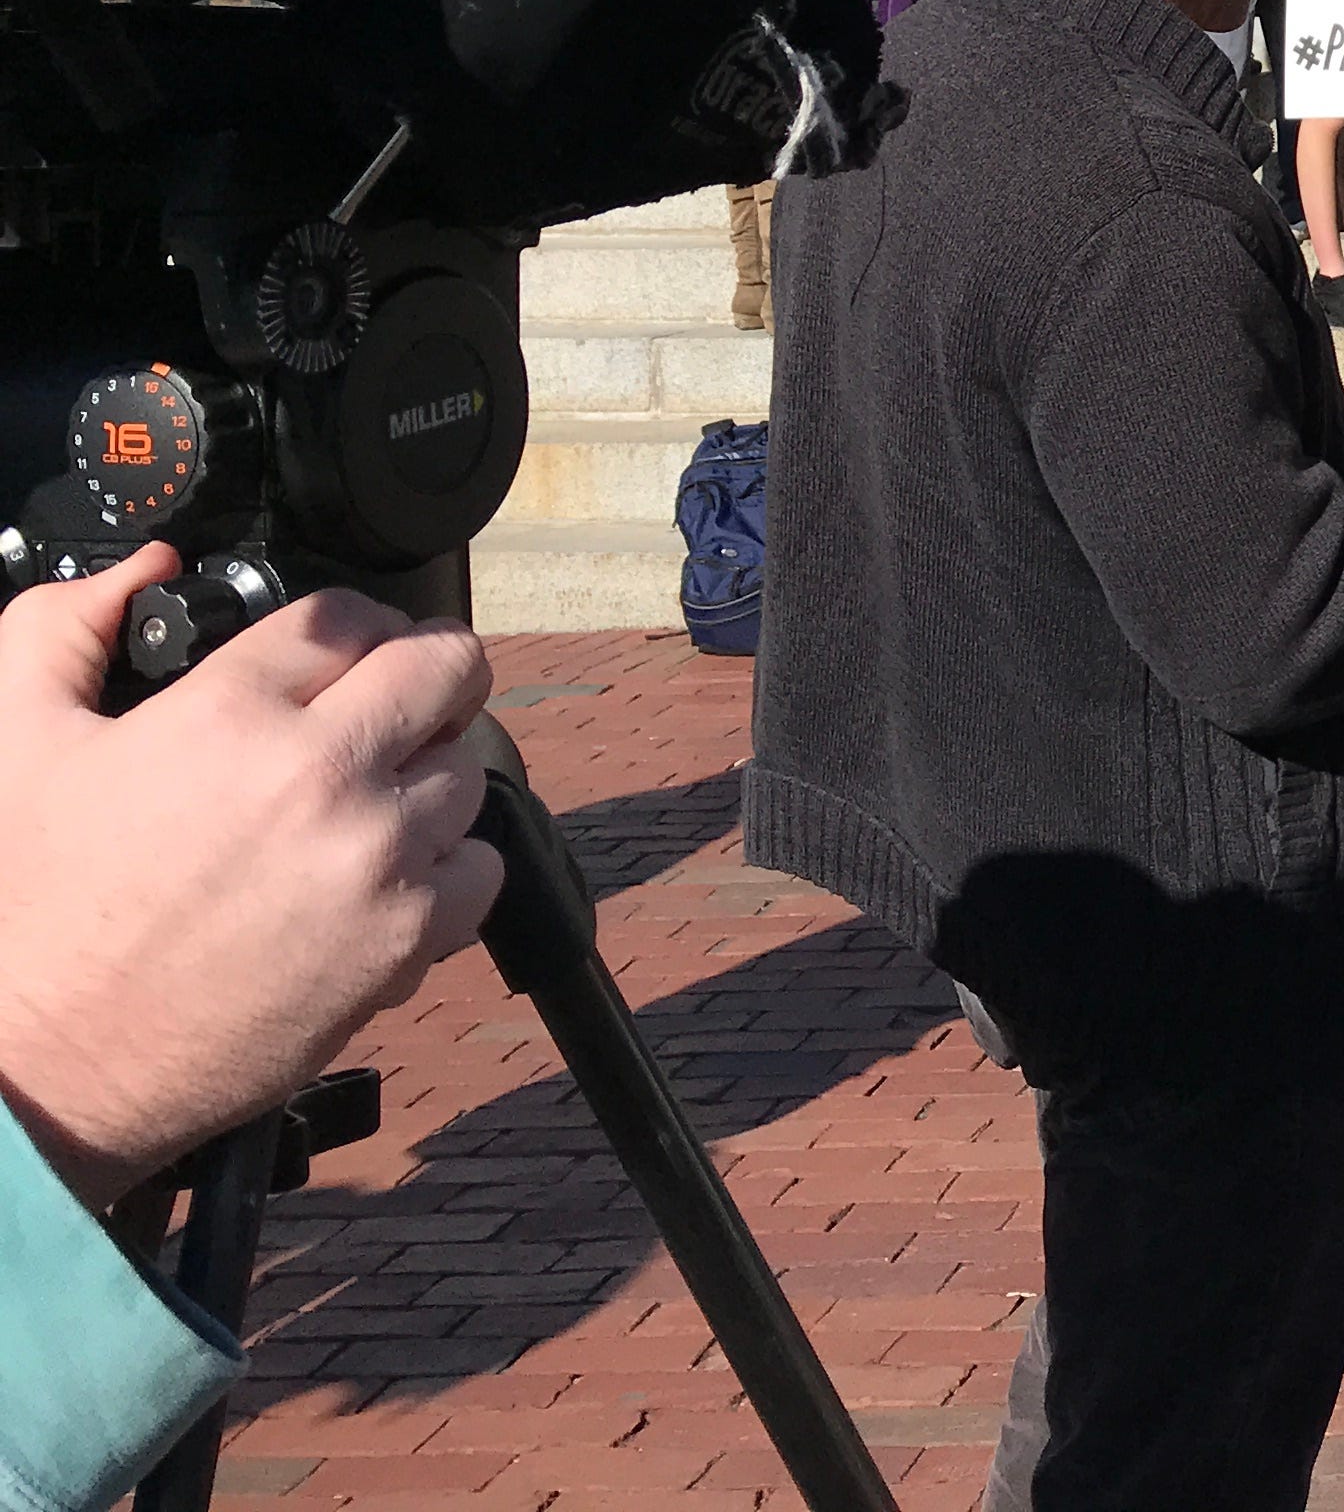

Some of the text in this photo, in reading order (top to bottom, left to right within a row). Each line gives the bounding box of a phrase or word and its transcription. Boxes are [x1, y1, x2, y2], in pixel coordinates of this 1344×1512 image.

[107, 379, 117, 392] 3
[129, 375, 136, 388] 1
[91, 392, 100, 405] 5
[161, 395, 176, 408] 14
[80, 411, 88, 423] 7
[171, 415, 188, 428] 12
[389, 392, 472, 440] MILLER
[73, 434, 83, 446] 9
[103, 421, 152, 455] 16
[175, 439, 192, 451] 10
[76, 458, 87, 470] 11
[175, 462, 186, 475] 8
[87, 479, 100, 491] 13
[163, 482, 175, 496] 6
[103, 493, 118, 506] 15
[144, 496, 158, 508] 4
[124, 500, 136, 513] 2
